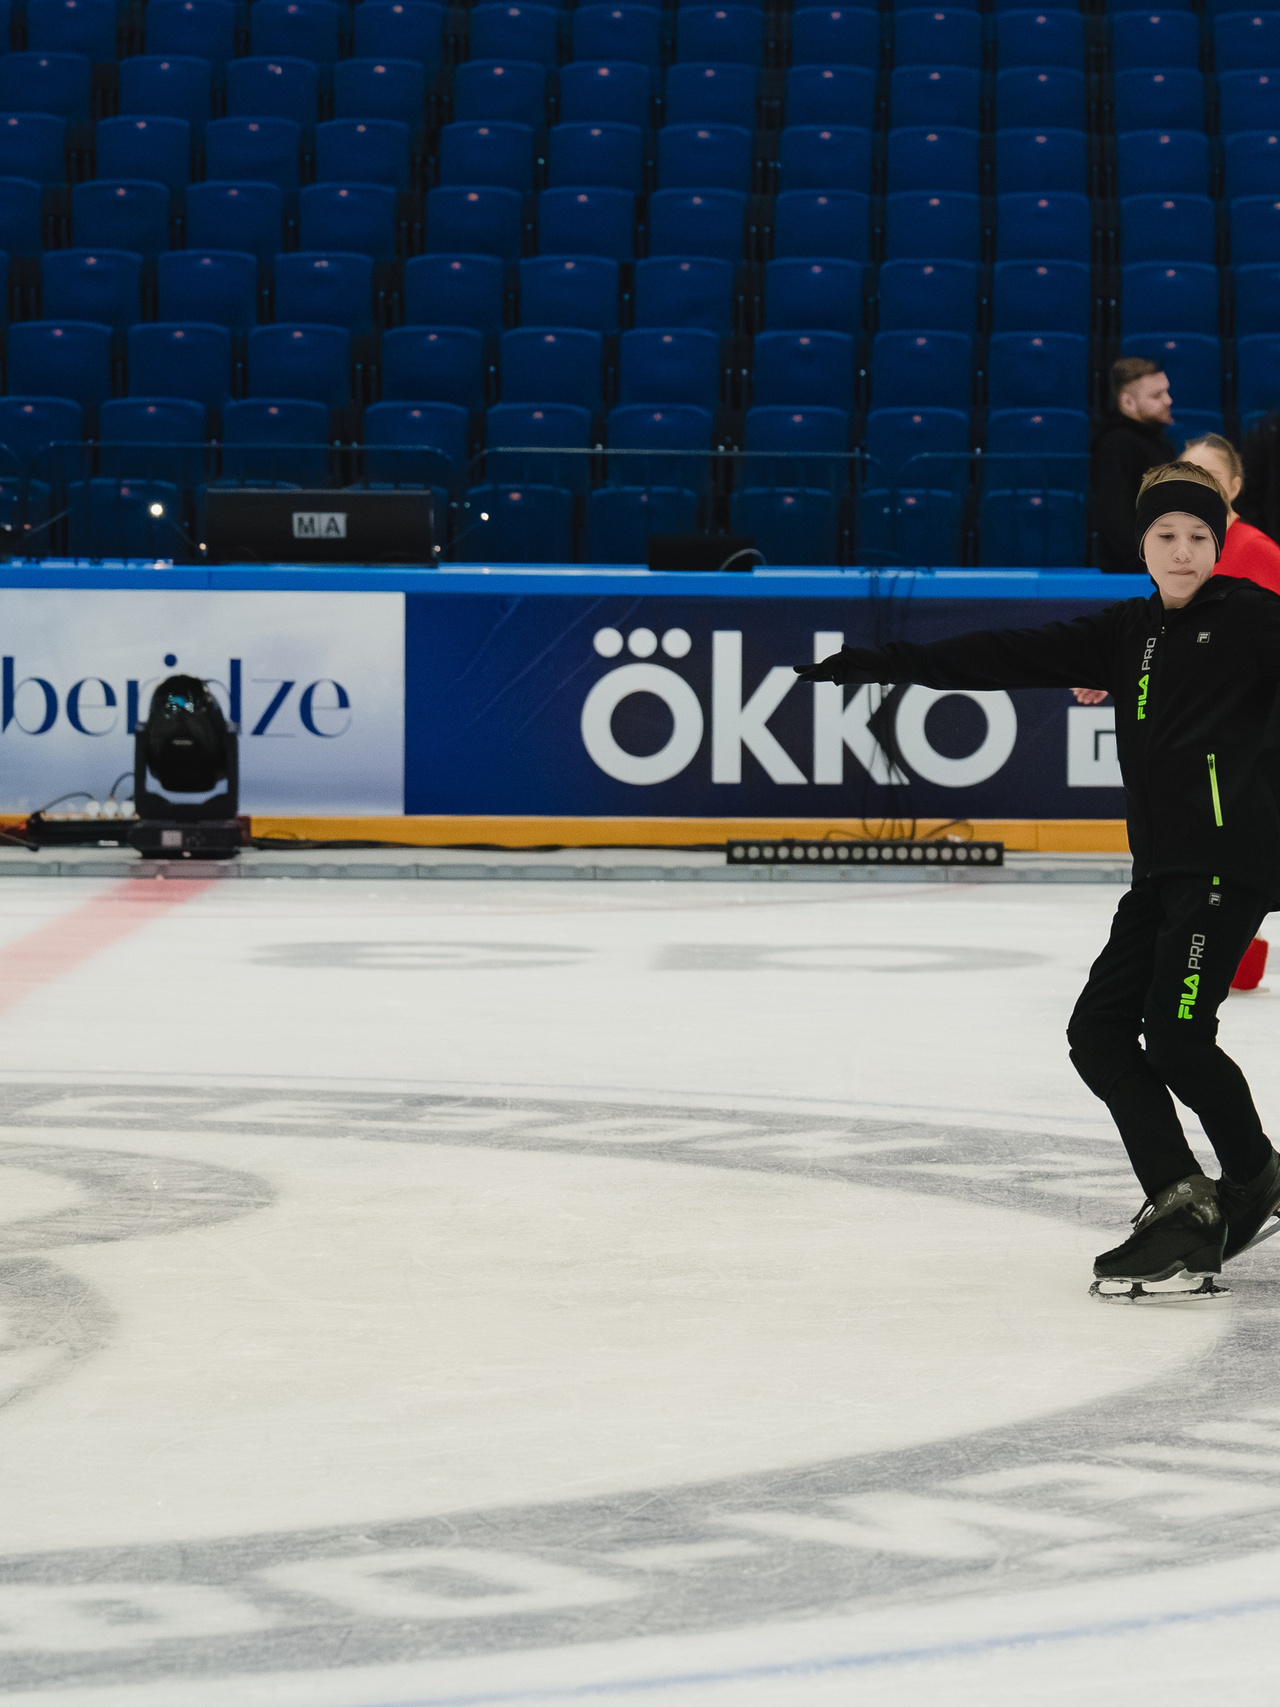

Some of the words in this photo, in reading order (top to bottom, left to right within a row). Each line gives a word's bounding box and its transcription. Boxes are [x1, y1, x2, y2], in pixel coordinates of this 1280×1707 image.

[1141, 637, 1157, 671] PRO
[1, 653, 351, 738] berdze
[1137, 674, 1150, 721] FILA
[1187, 933, 1206, 970] PRO
[1177, 973, 1200, 1020] FILA
[14, 1094, 952, 1164] СЕЗОН
